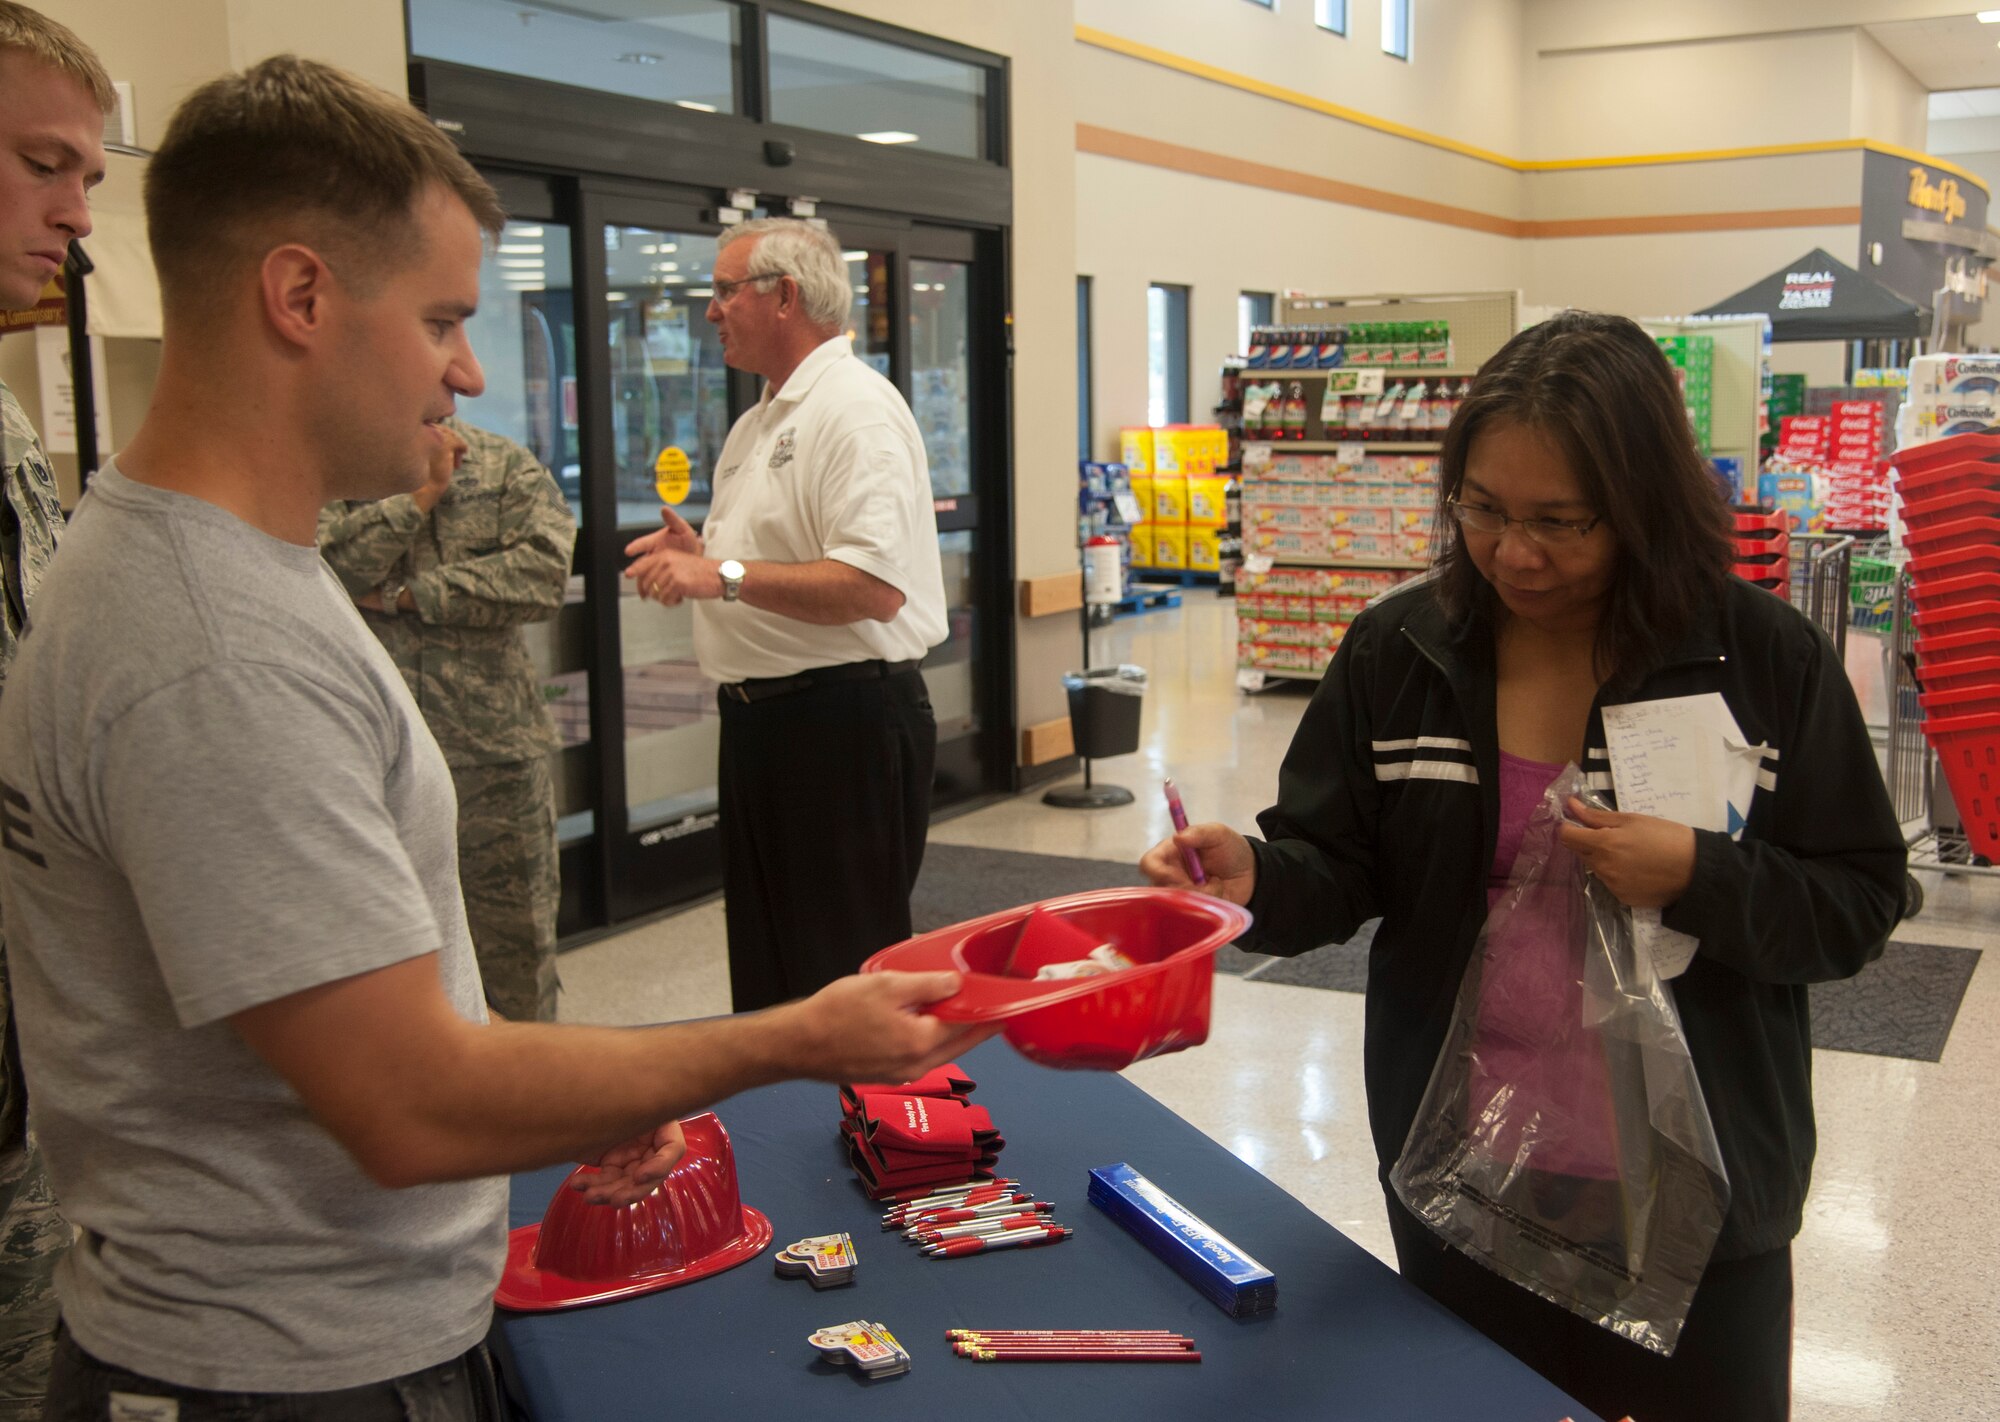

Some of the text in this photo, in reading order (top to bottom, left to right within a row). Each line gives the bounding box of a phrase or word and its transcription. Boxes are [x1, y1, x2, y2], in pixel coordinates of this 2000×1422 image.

[1785, 270, 1836, 285] REAL
[1947, 407, 1996, 418] Cottonelle
[906, 1110, 918, 1128] Moody
[914, 1097, 930, 1133] Fire Department
[1180, 1223, 1205, 1243] AFB
[1202, 1239, 1236, 1264] Moody
